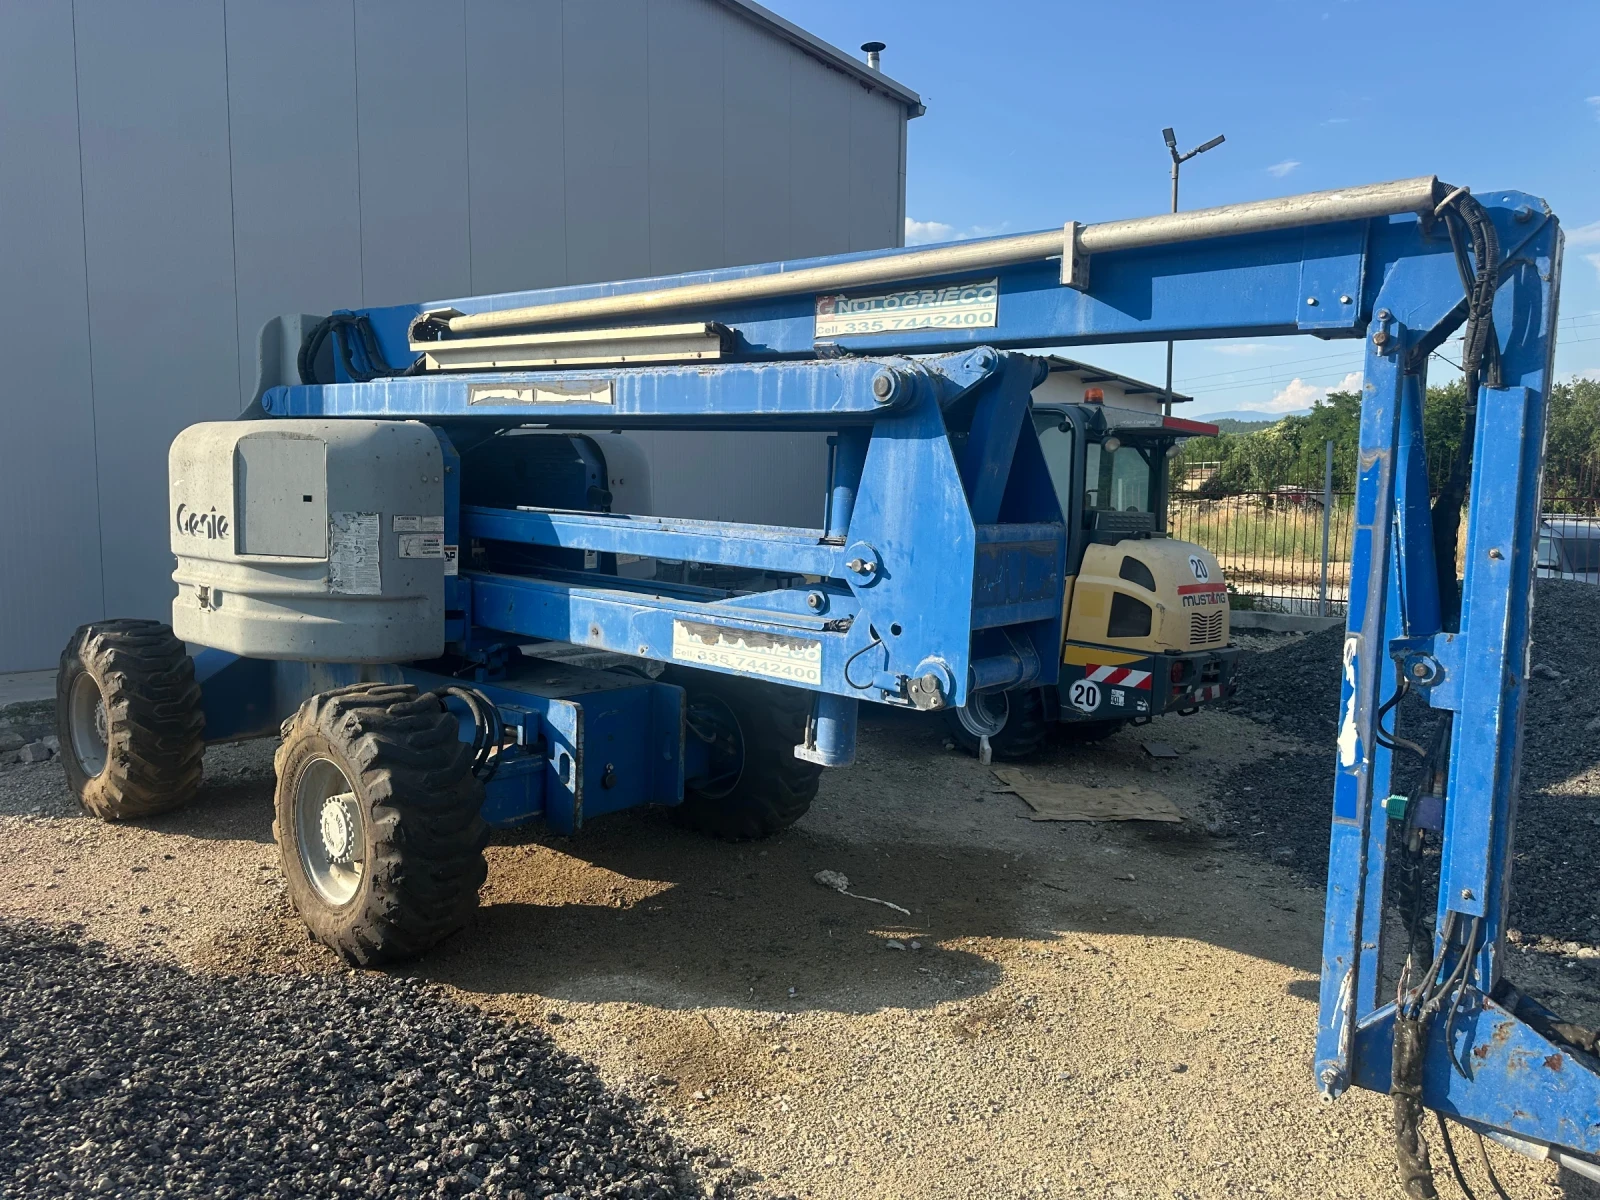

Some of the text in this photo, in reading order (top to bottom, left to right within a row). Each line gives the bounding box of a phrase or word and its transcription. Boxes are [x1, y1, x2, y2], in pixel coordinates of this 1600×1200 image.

[176, 503, 230, 540] Genie
[1190, 559, 1208, 579] 20
[1073, 684, 1097, 707] 20
